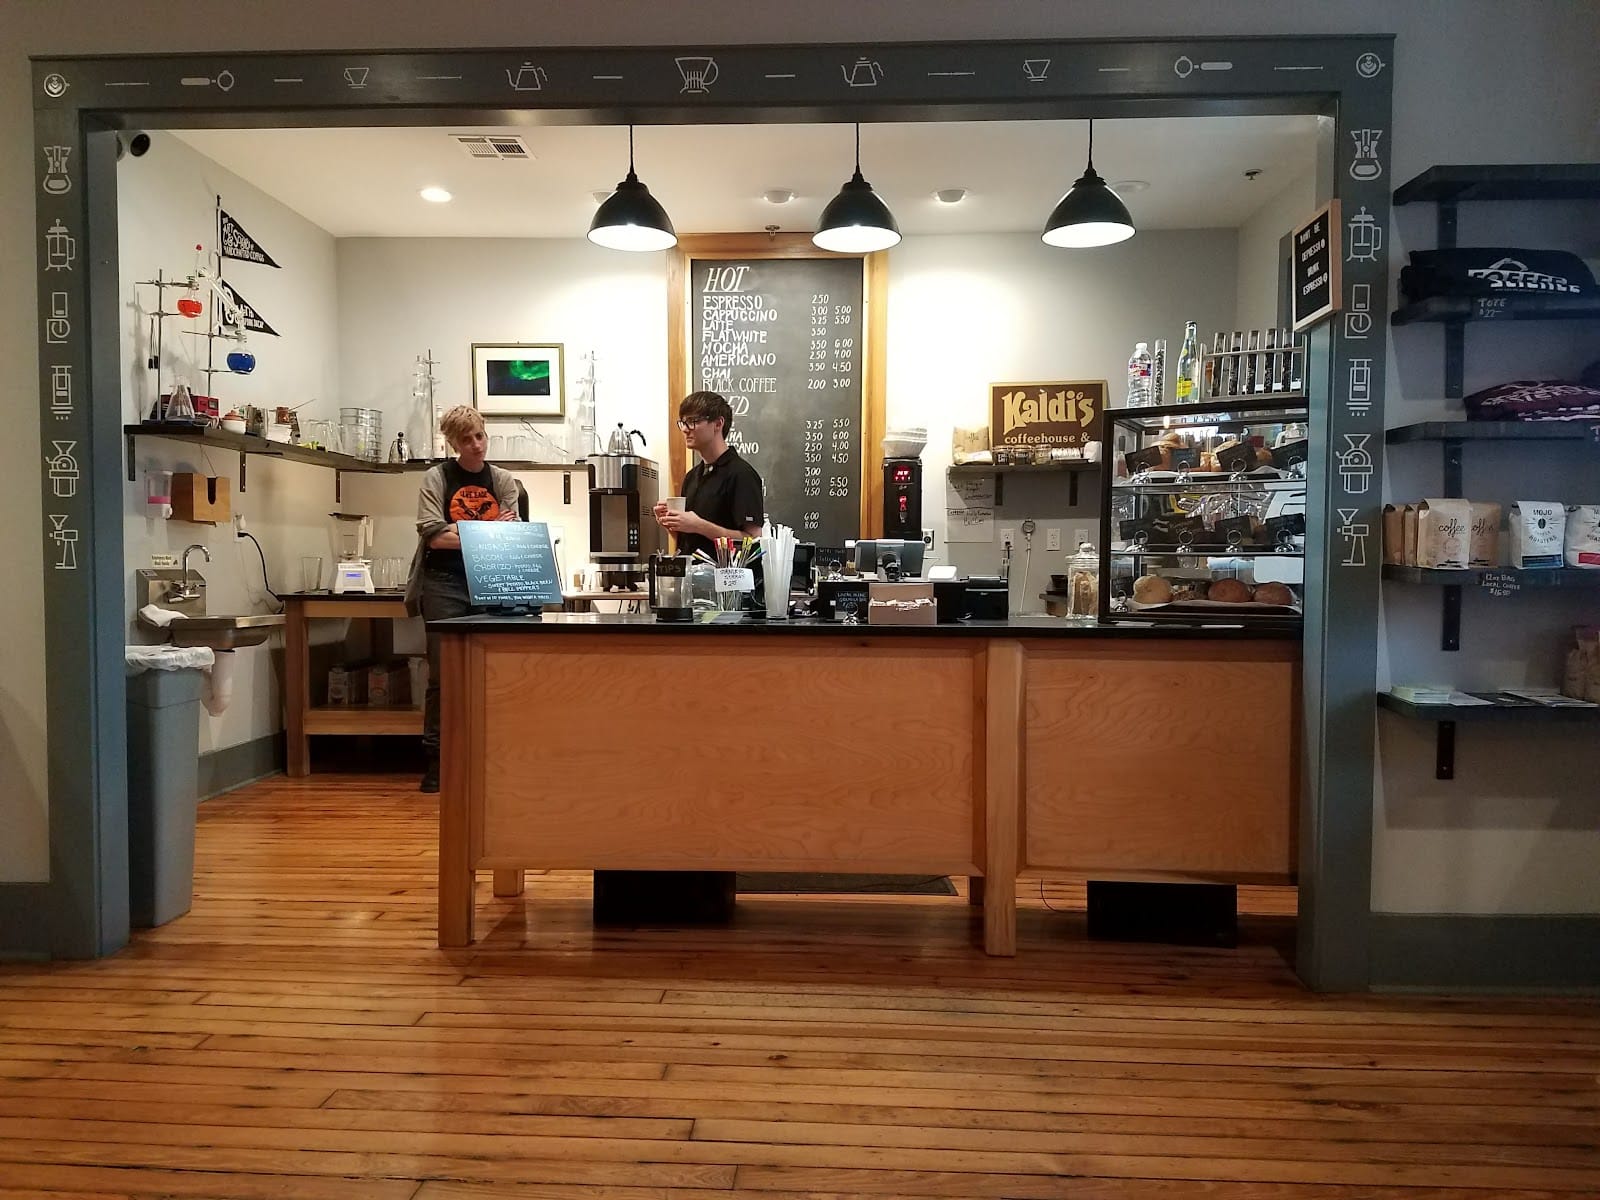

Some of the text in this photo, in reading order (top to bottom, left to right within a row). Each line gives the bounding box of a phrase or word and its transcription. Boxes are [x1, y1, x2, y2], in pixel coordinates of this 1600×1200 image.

[703, 266, 749, 292] HOT
[703, 296, 762, 310] ESPRESSO
[1478, 298, 1506, 307] TOTE
[703, 310, 778, 322] CAPPUCCINO
[702, 319, 734, 331] LATTE
[702, 342, 748, 354] MOCHA
[701, 353, 776, 367] AMERICANO
[702, 368, 730, 379] CHAI
[702, 378, 734, 392] BLACK
[739, 378, 776, 392] COFFEE
[1002, 390, 1095, 436] Kaldi's
[1004, 432, 1090, 444] coffeehouse &
[830, 476, 848, 488] 5.50
[1438, 518, 1465, 538] coffee
[472, 554, 504, 562] BACON
[474, 564, 512, 572] CHORIZO
[658, 564, 682, 574] TIPS
[475, 574, 526, 584] VEGETABLE
